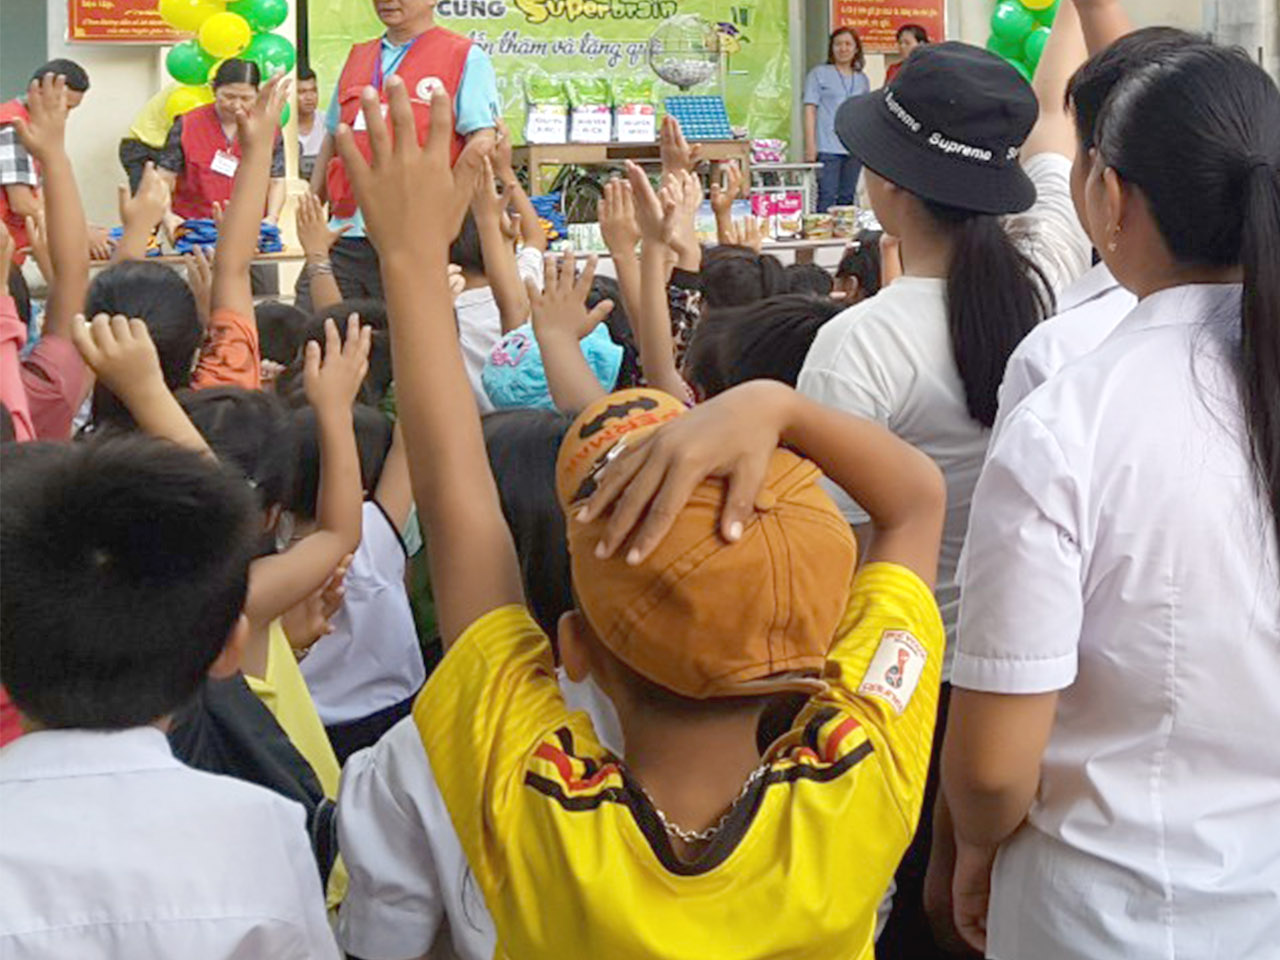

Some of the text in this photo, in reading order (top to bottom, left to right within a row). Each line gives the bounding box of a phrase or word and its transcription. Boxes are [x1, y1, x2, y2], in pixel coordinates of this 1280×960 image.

[552, 38, 575, 55] và
[579, 32, 623, 67] tặng
[928, 131, 993, 161] Supreme
